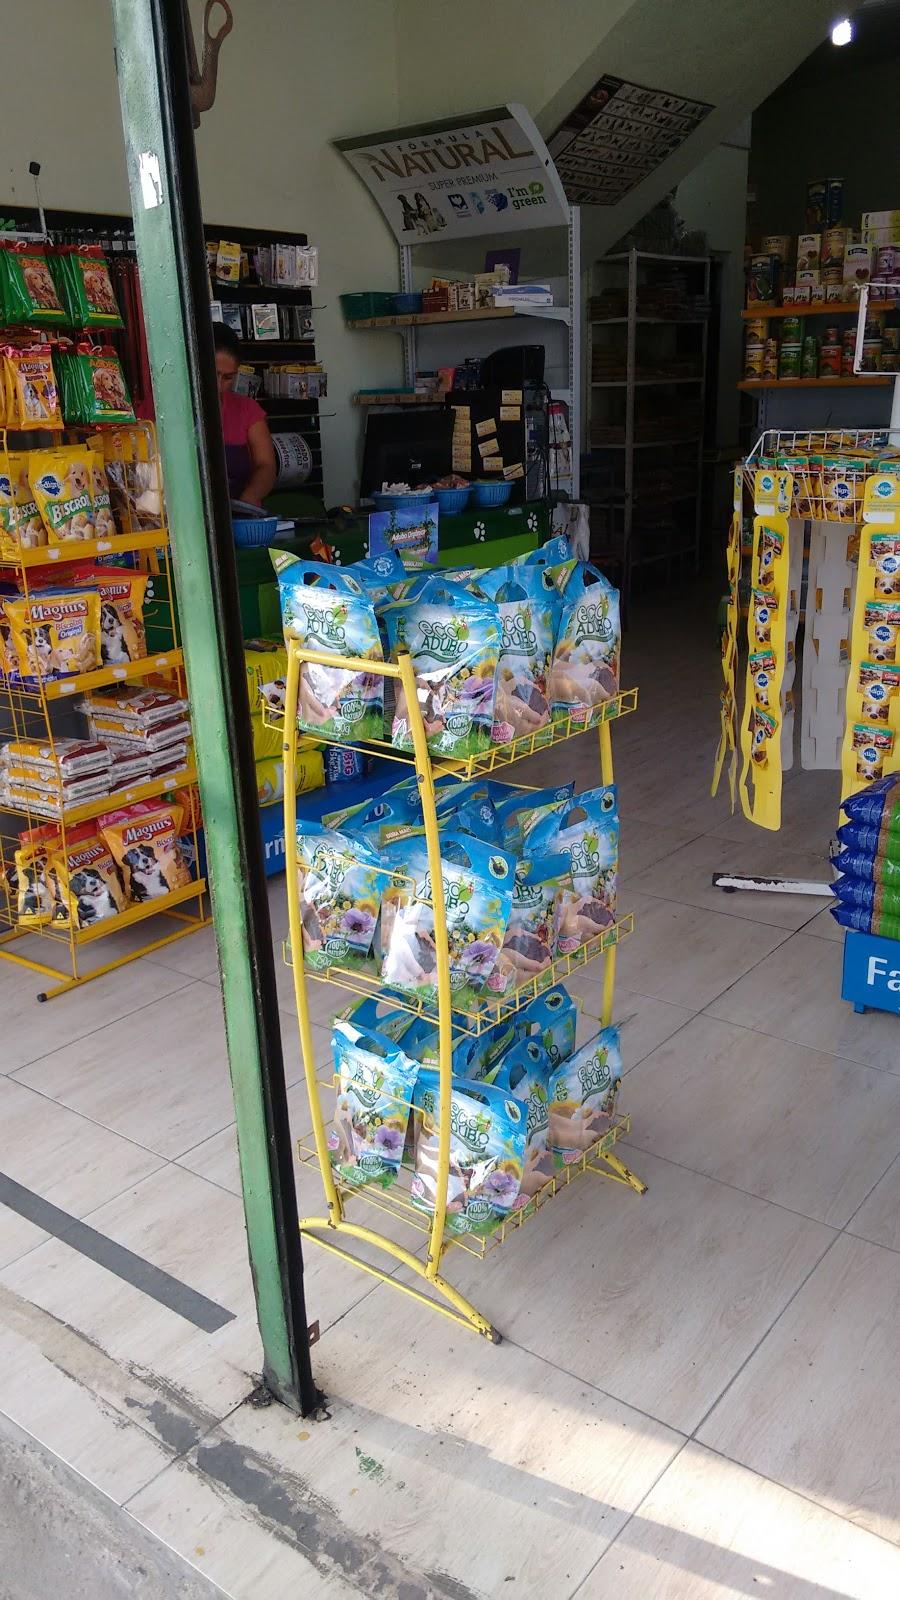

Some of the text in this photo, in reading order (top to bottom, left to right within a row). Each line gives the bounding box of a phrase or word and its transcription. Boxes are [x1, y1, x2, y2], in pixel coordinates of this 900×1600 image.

[369, 127, 534, 182] NATURAL
[428, 172, 499, 191] SUPER PREMIUM
[507, 187, 529, 198] I'm
[512, 196, 547, 210] green
[100, 585, 129, 600] agnus
[30, 601, 86, 620] Magnus
[576, 604, 604, 624] eco
[419, 620, 458, 641] eco
[576, 618, 612, 636] ADUBO
[421, 636, 468, 654] ADUBO
[123, 818, 172, 846] Magnus
[67, 846, 104, 868] Magnus
[578, 1056, 602, 1082] eco
[581, 1065, 610, 1094] ADUBO
[451, 1122, 489, 1145] DUBO
